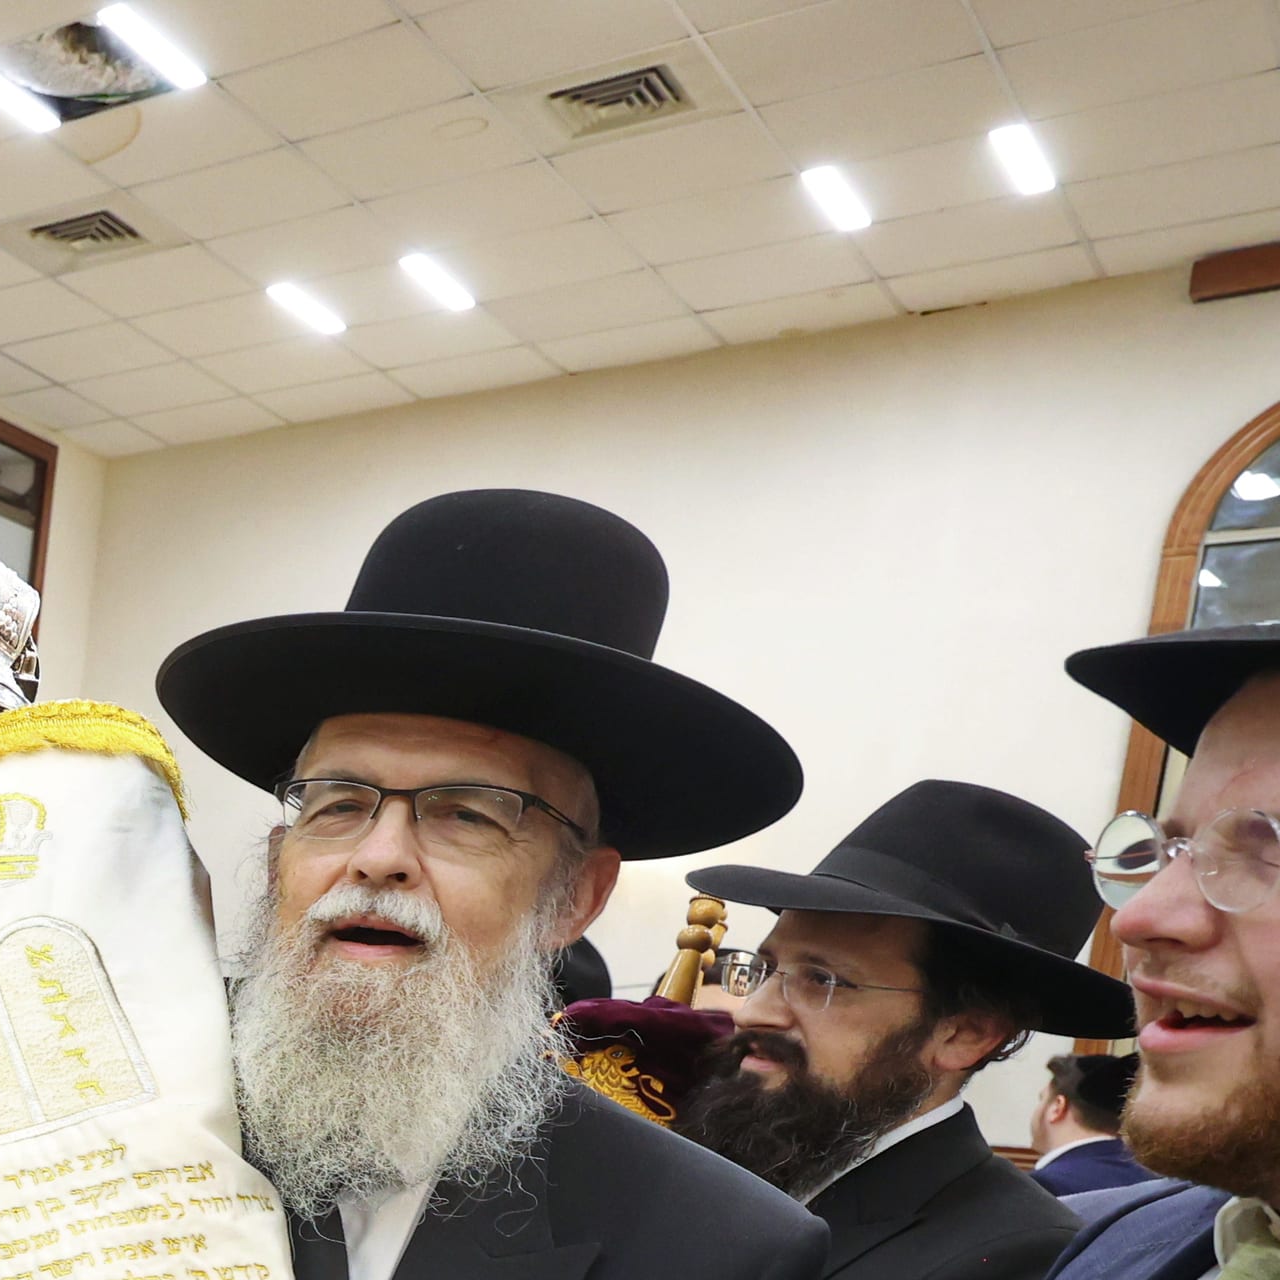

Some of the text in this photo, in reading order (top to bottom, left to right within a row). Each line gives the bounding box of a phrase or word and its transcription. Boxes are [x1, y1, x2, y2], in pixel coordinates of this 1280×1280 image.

[132, 1160, 215, 1190] אברהם
[69, 1177, 127, 1210] יעקב
[188, 1196, 233, 1214] יחיד
[34, 1197, 66, 1221] בן
[66, 1191, 186, 1236] למשפחתו
[101, 1238, 158, 1265] אמת
[161, 1232, 208, 1256] איש
[38, 1251, 96, 1279] וישר
